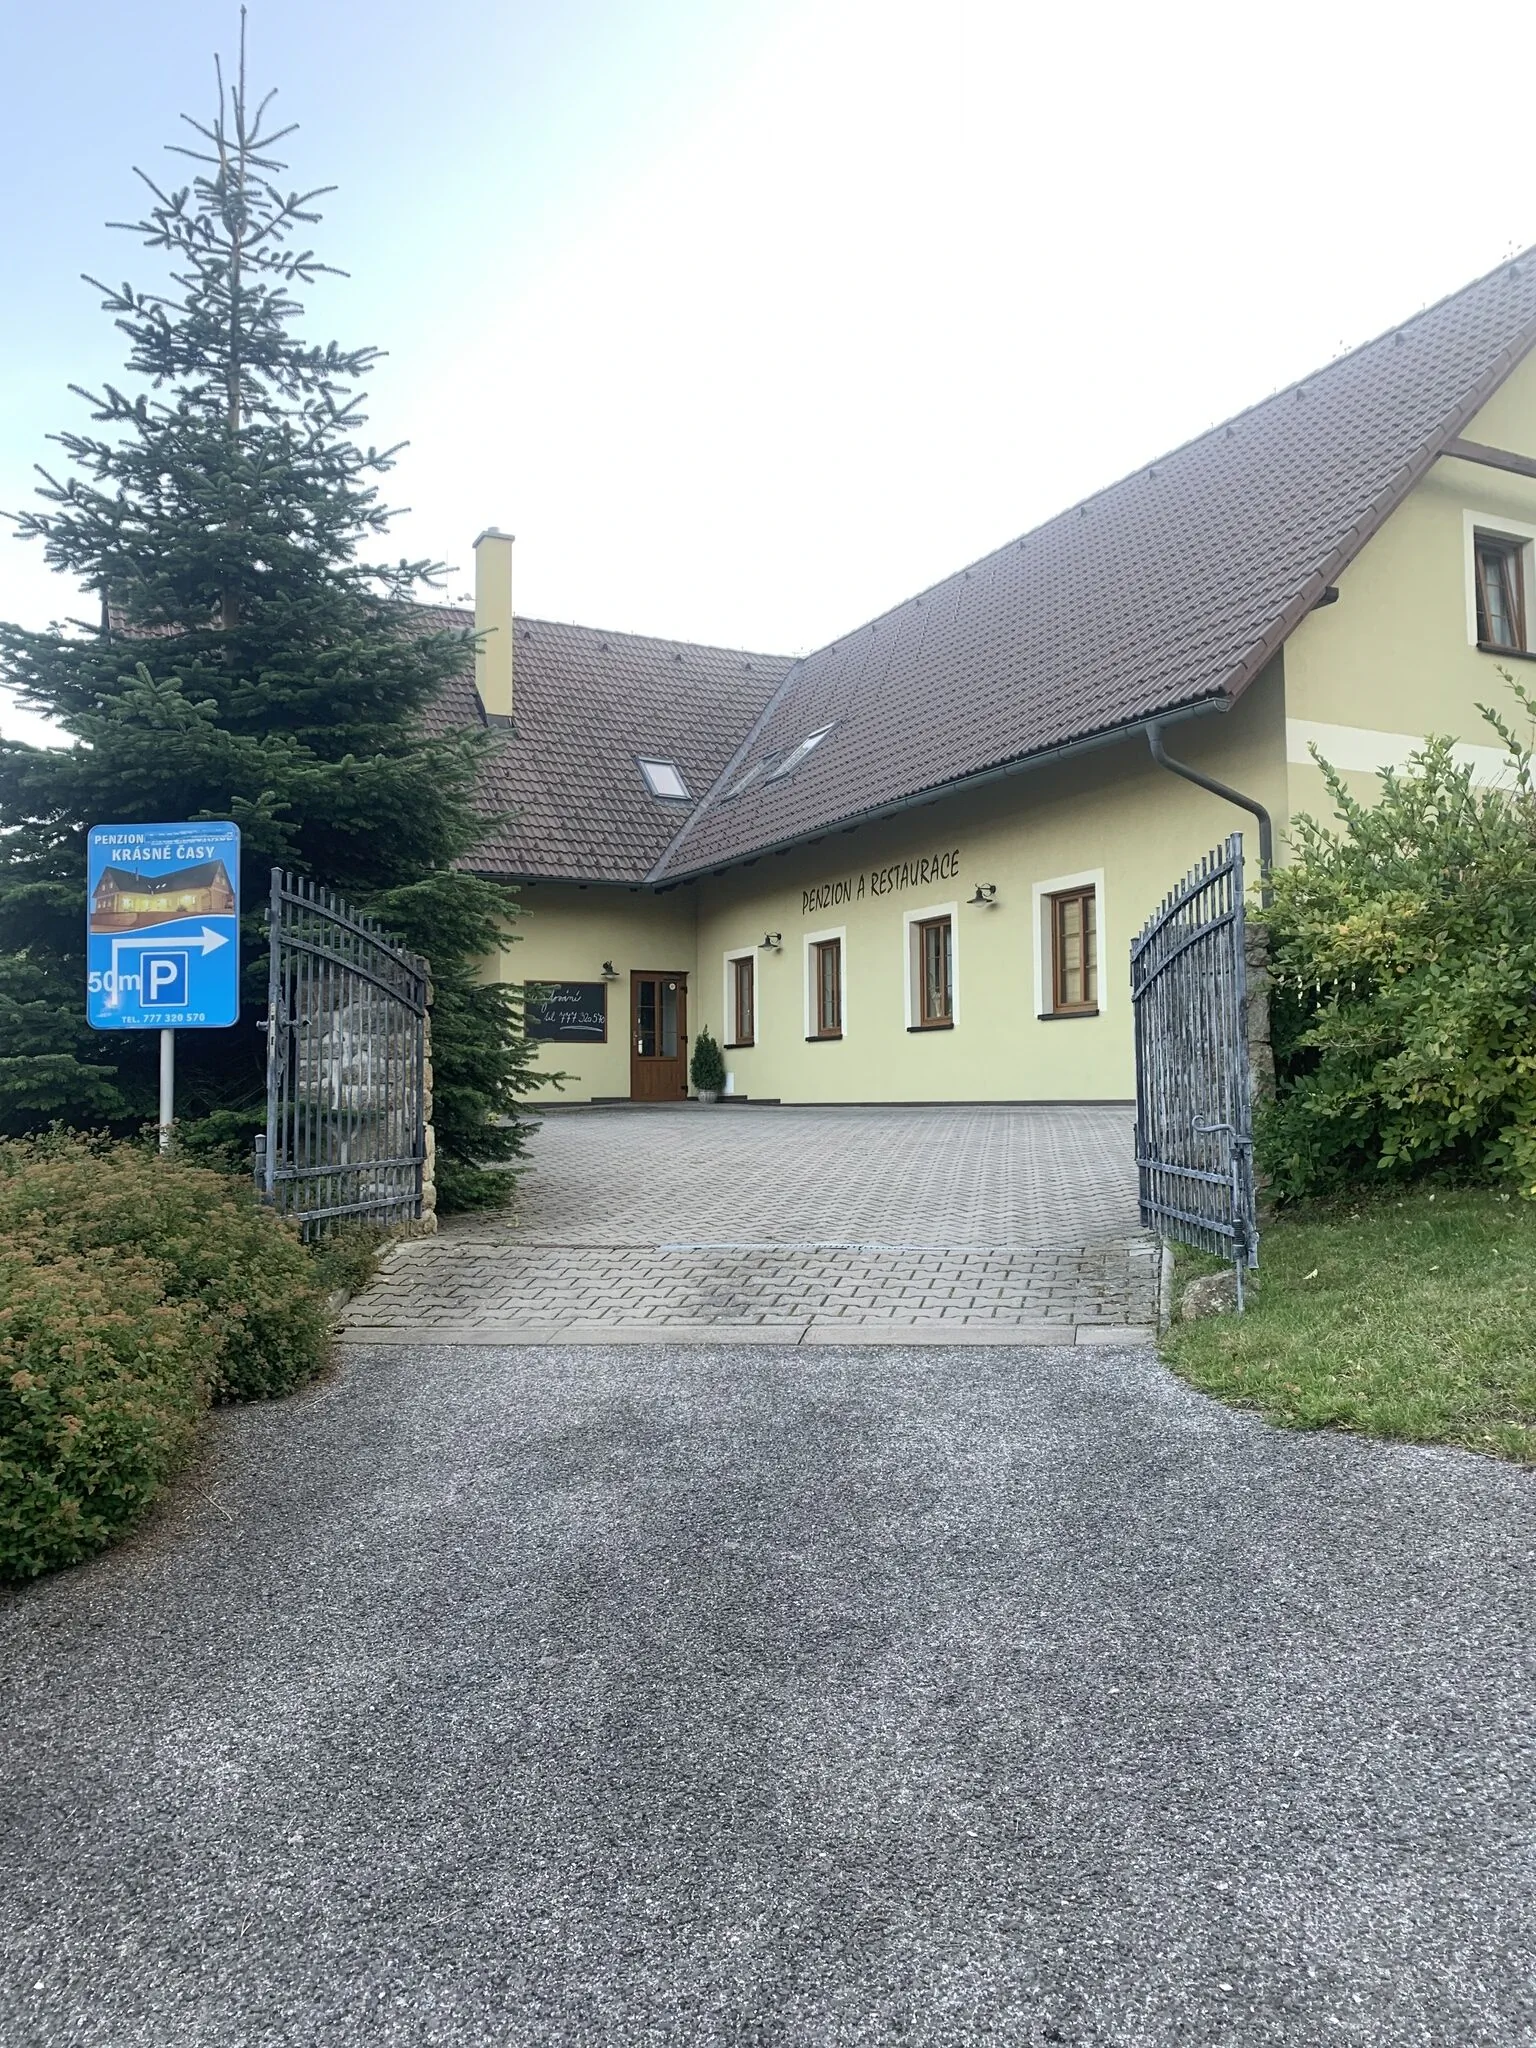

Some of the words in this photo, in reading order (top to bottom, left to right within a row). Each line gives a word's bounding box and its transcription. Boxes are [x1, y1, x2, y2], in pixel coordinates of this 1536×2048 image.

[94, 834, 144, 845] PENZION
[112, 845, 171, 861] KRÁSNÉ
[176, 844, 215, 860] ČASY
[802, 877, 852, 915] PENZION
[856, 873, 865, 900] A
[870, 849, 959, 897] RESTAURACE
[150, 960, 178, 1000] P
[122, 1015, 140, 1023] TEL.
[143, 1014, 162, 1023] 777
[165, 1013, 183, 1022] 320
[186, 1013, 205, 1022] 570
